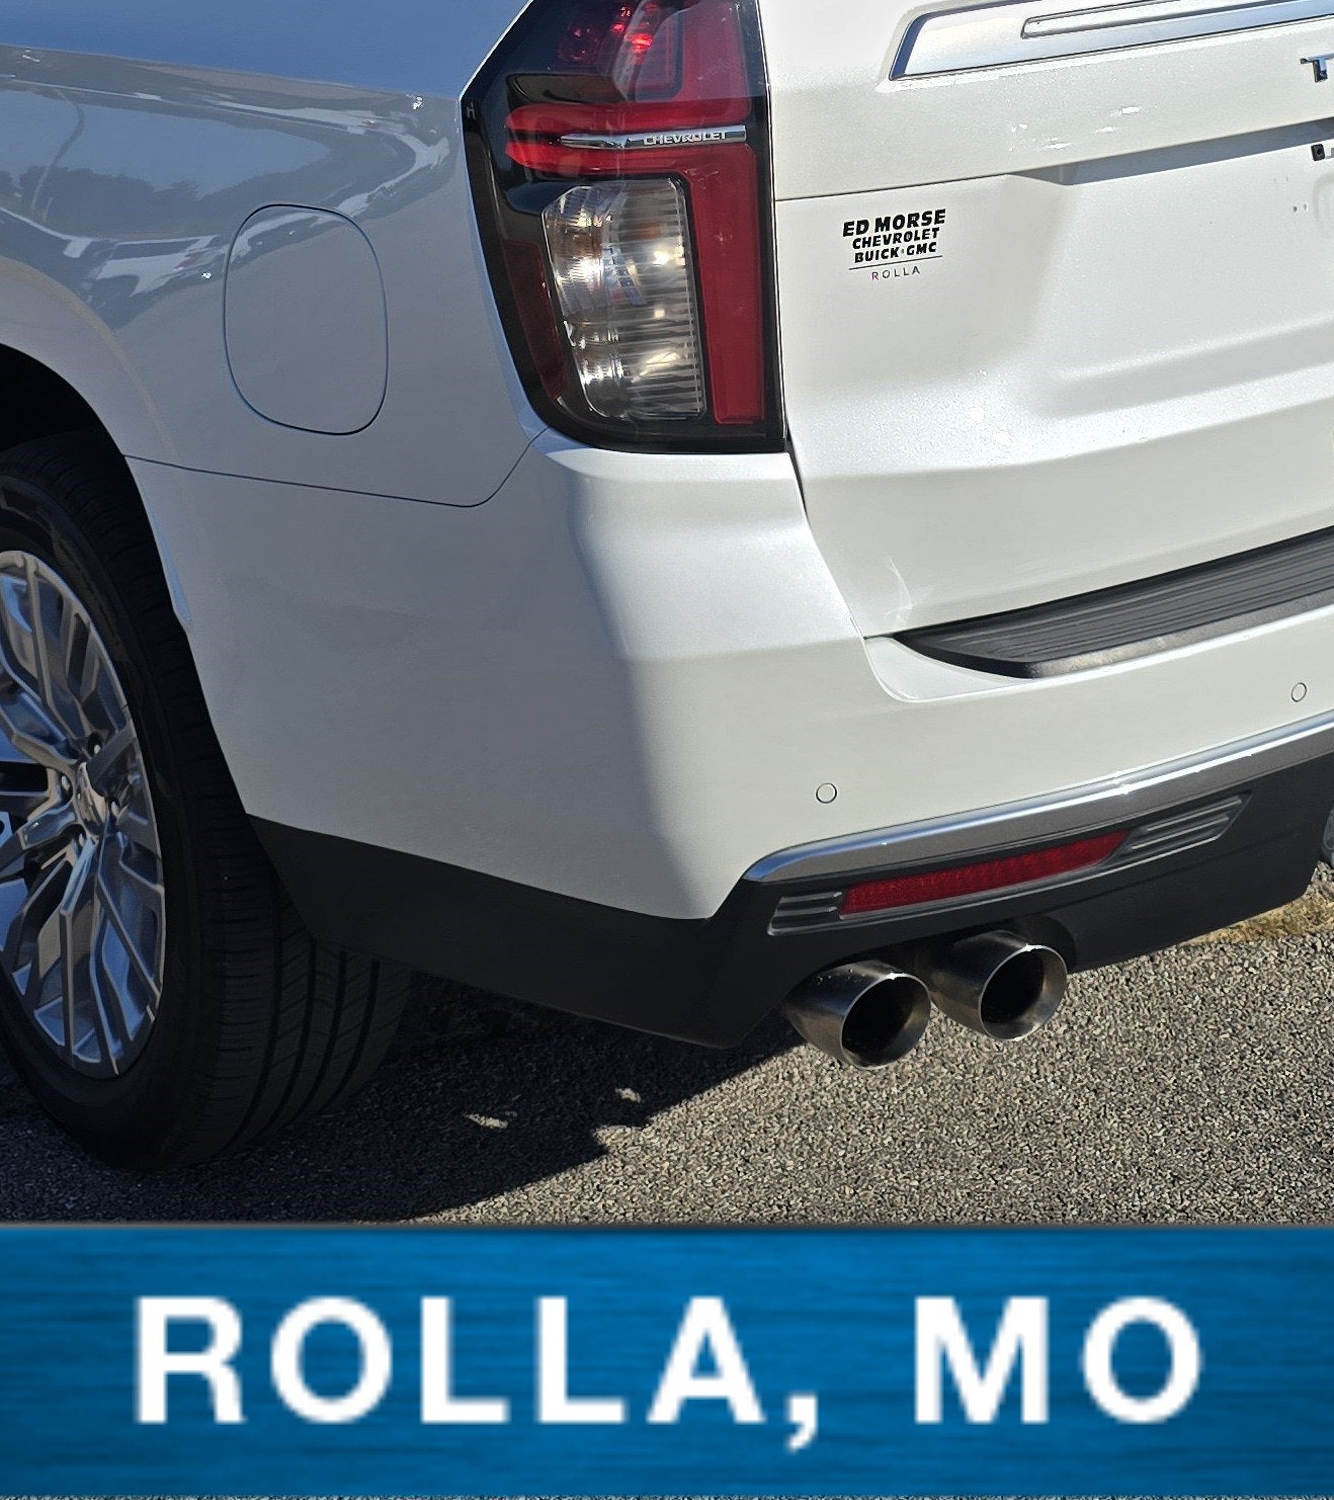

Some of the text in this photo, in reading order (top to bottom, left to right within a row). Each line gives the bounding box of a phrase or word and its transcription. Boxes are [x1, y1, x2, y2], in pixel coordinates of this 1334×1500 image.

[643, 130, 728, 146] CHEVROLET
[843, 208, 946, 237] ED MORSE
[852, 227, 940, 249] CHEVROLET
[871, 266, 921, 280] ROLLA
